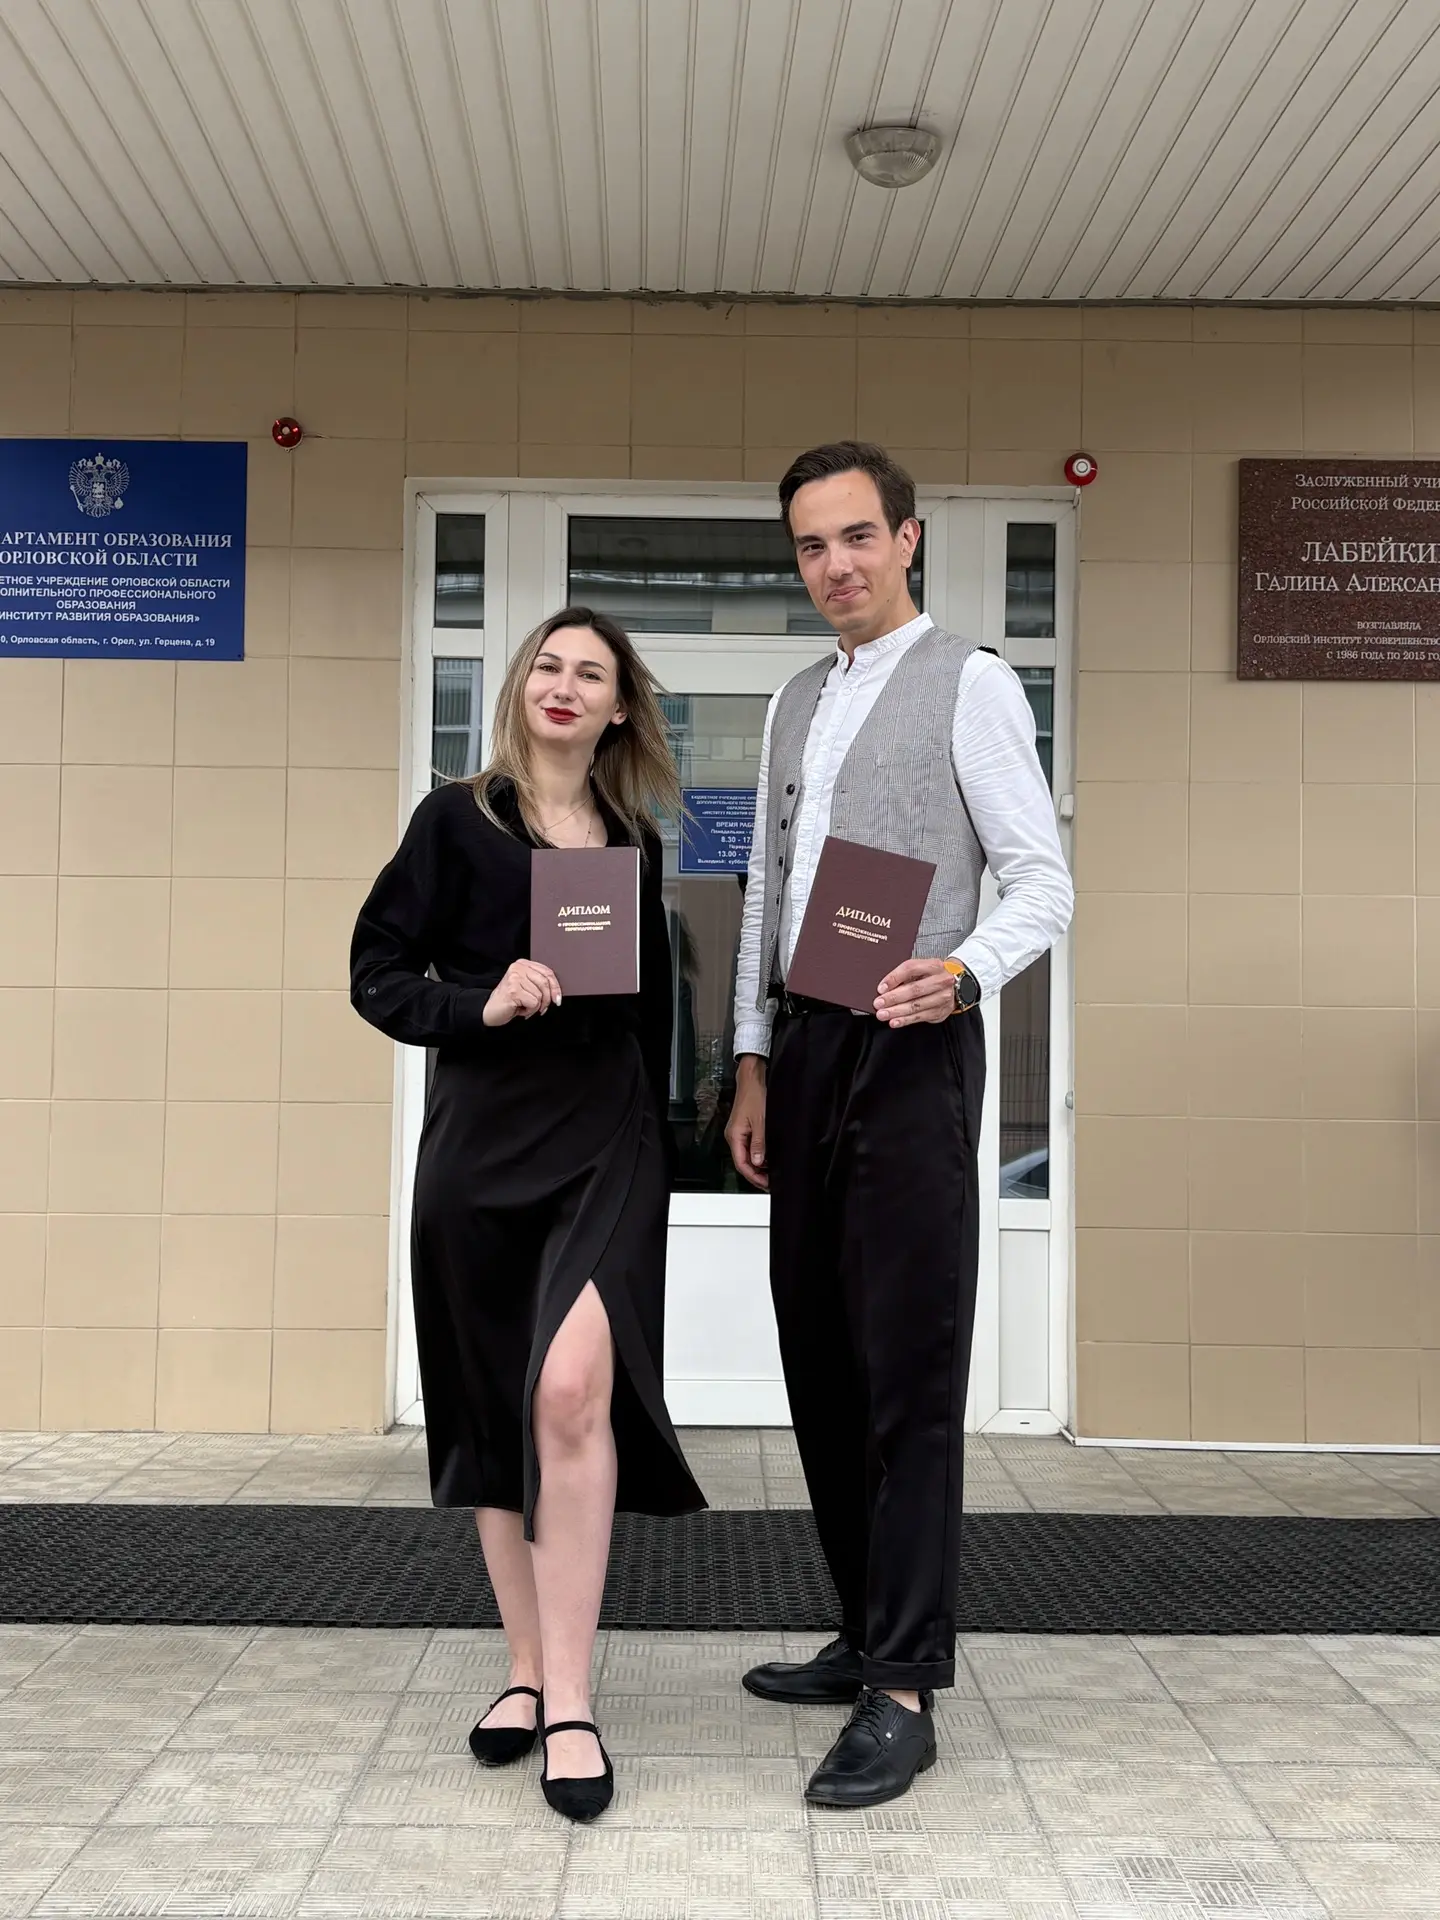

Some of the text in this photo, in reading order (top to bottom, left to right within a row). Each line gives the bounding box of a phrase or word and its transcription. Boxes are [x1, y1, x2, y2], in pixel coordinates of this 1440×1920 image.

[0, 531, 233, 548] АРТАМЕНТ ОБРАЗОВАНИЯ
[1301, 536, 1440, 564] ЛАБЕЙКИ
[0, 549, 198, 567] ОРЛОВСКОЙ ОБЛАСТИ
[36, 576, 109, 587] УЧРЕЖДЕНИЕ
[111, 577, 177, 588] ОРЛОВСКОЙ
[179, 578, 231, 589] ОБЛАСТИ
[1254, 572, 1340, 592] ГАЛИНА
[0, 587, 216, 600] ОЛНИТЕЛЬНОГО ПРОФЕССИОНАЛЬНОГО
[56, 600, 136, 611] ОБРАЗОВАНИЯ
[55, 612, 111, 622] РАЗВИТИЯ
[113, 612, 200, 624] ОБРАЗОВАНИЯ»
[10, 635, 59, 645] Орловская
[61, 636, 100, 646] область,
[103, 637, 110, 645] г.
[111, 636, 137, 647] Орел,
[138, 638, 153, 647] ул.
[154, 637, 194, 648] Герцена,
[205, 638, 216, 647] 19
[1336, 650, 1359, 660] 1986
[1403, 651, 1426, 661] 2015
[1428, 652, 1440, 661] ГО
[718, 850, 737, 858] 13.00
[558, 905, 611, 917] ДИПЛОМ
[836, 906, 891, 928] ДИПЛОМ
